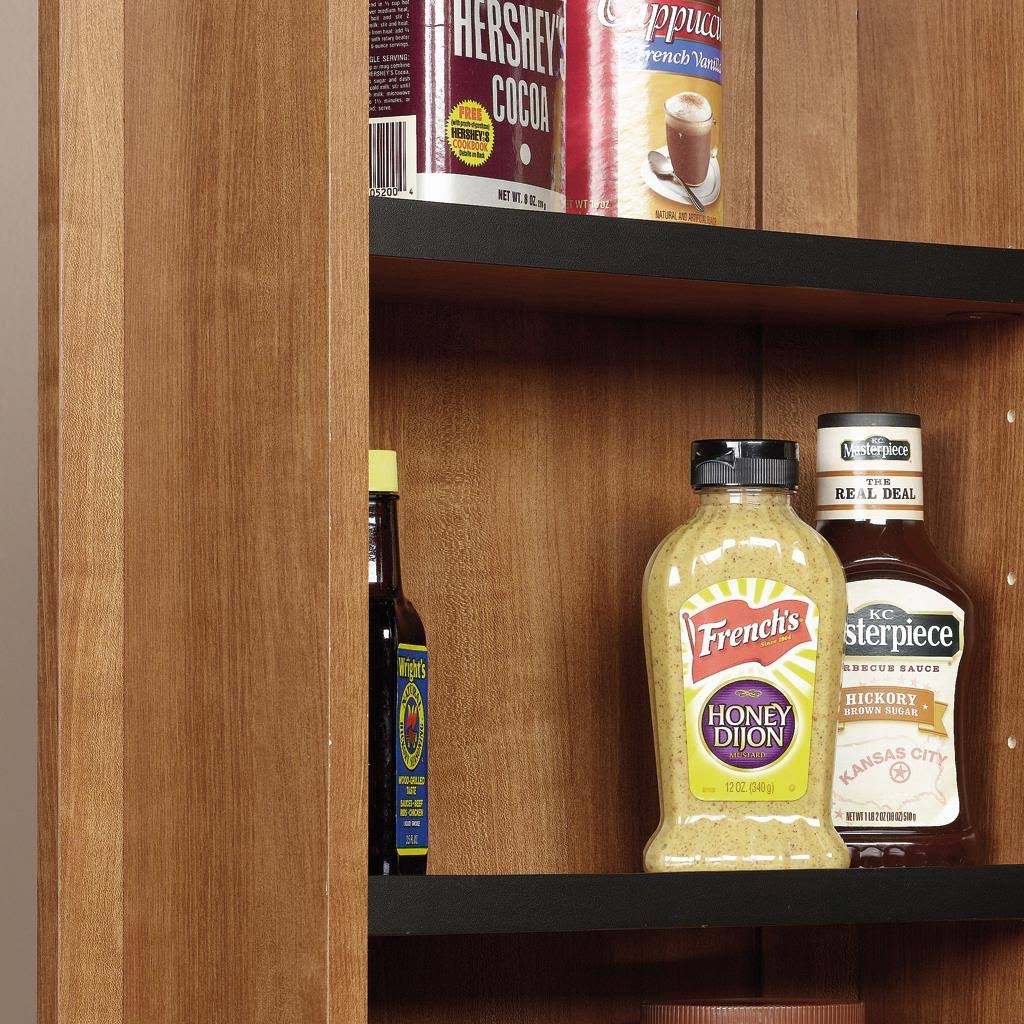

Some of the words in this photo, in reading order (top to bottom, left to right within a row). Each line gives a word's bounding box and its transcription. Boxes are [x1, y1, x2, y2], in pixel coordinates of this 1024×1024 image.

[454, 0, 566, 82] HERSHEY'S
[492, 74, 549, 132] COCOA
[458, 105, 482, 120] FREE
[451, 128, 490, 142] HERSHEY'S
[452, 139, 488, 151] COOKBOOK
[369, 187, 398, 196] 05200
[498, 189, 512, 202] NET
[843, 442, 908, 459] Masterpiece
[835, 488, 877, 500] REAL
[883, 488, 916, 500] DEAL
[869, 609, 894, 620] KC
[698, 607, 800, 658] French's
[845, 618, 953, 653] sterpiece
[398, 656, 426, 682] Wright's
[843, 664, 895, 673] RBECUE
[900, 665, 940, 673] SAUCE
[845, 692, 917, 706] HICKORY
[707, 702, 793, 726] HONEY
[844, 706, 882, 716] BROWN
[885, 706, 918, 717] SUGAR
[713, 726, 784, 751] DIJON
[729, 751, 766, 759] MUSTARD
[838, 747, 906, 786] KANSAS
